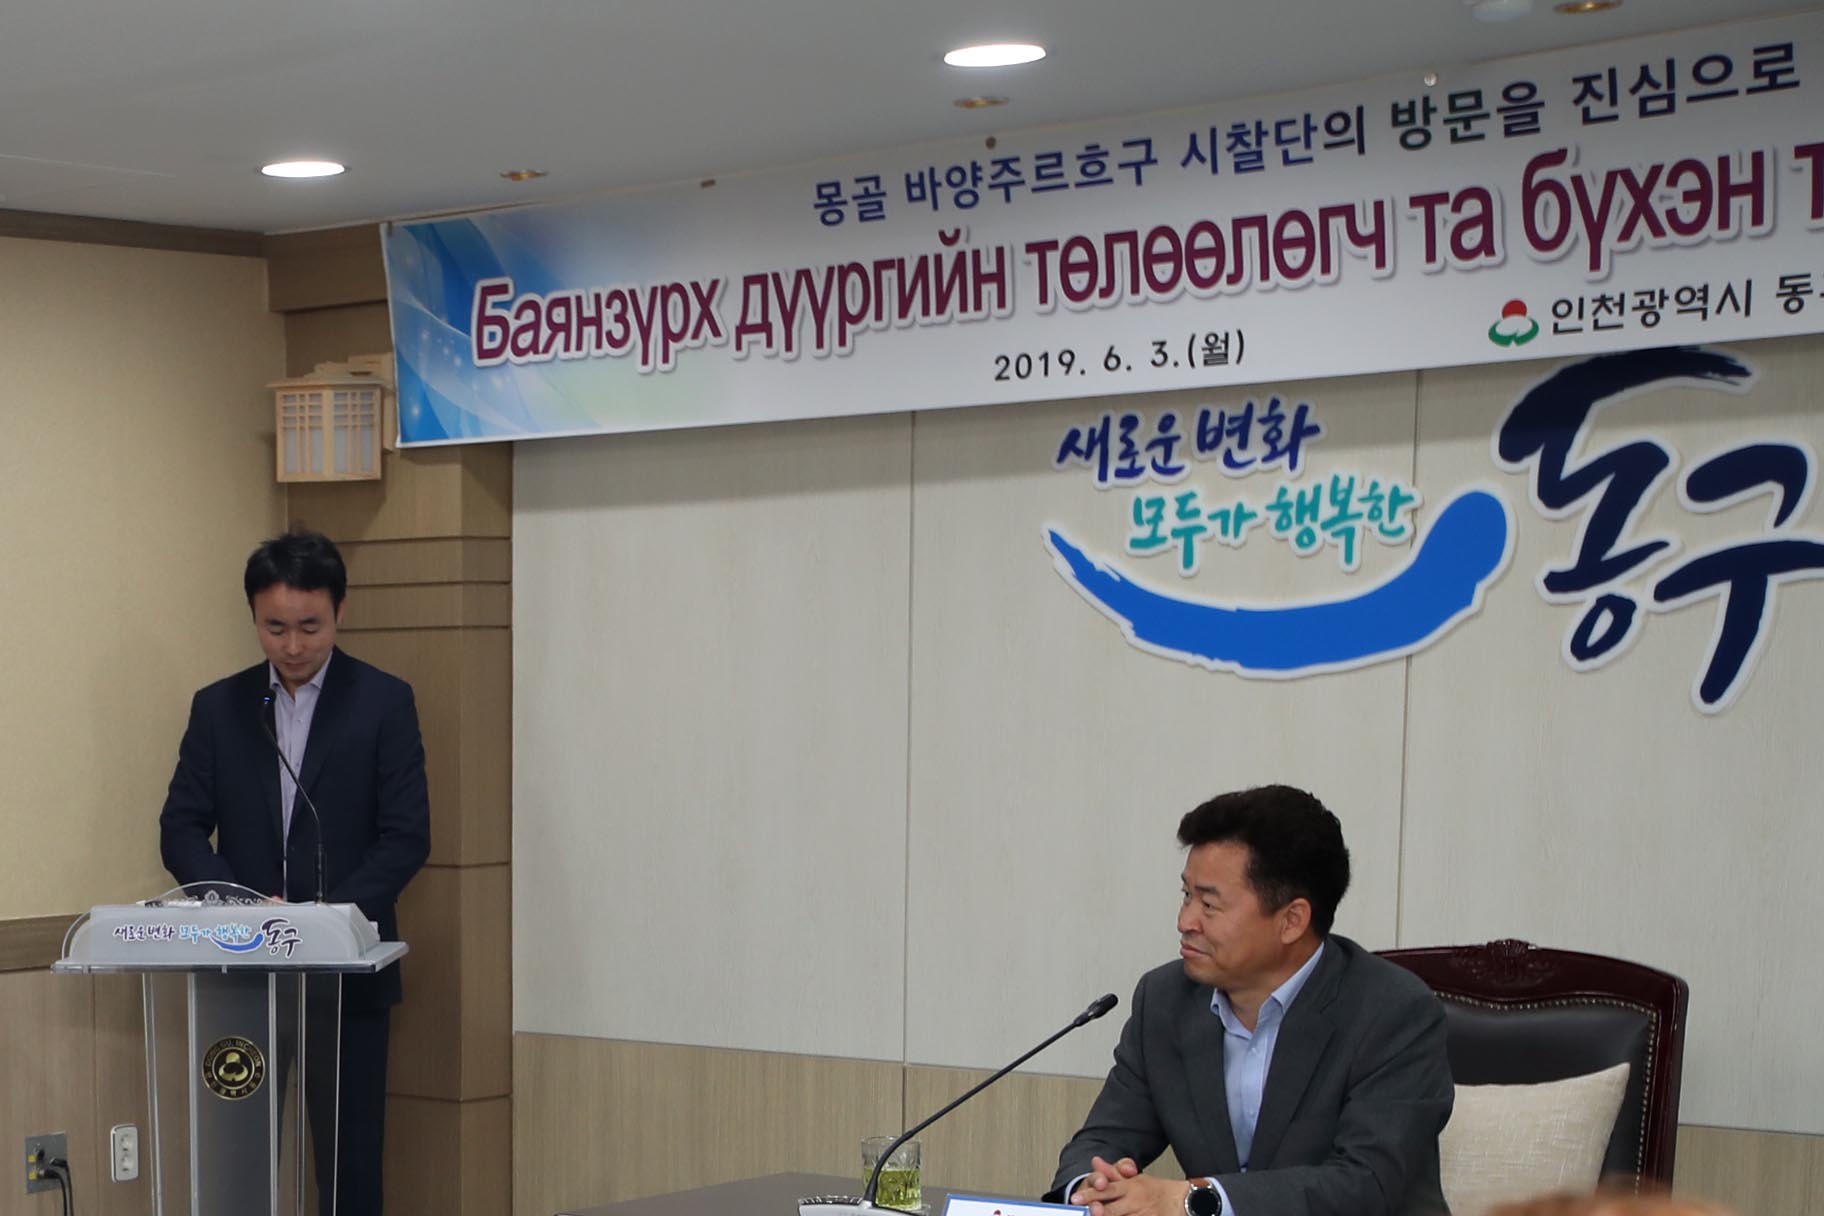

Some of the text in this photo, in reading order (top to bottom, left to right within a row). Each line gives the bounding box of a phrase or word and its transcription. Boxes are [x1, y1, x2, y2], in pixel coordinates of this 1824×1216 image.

[813, 42, 1800, 226] 몽골 바양주르흐구 시찰단의 방문을 진심으로
[1025, 200, 1387, 305] төлөөлөгч
[1409, 186, 1496, 264] та
[1521, 147, 1765, 273] бүхэн
[1551, 272, 1824, 336] 인천광역시 동
[994, 348, 1087, 382] 2019.
[1102, 344, 1132, 373] 6.
[1055, 397, 1322, 483] 새로운 변화
[1128, 473, 1415, 571] 모두가 행복한
[1498, 345, 1824, 705] 동구
[113, 925, 145, 941] 새로운
[261, 917, 303, 957] 동구
